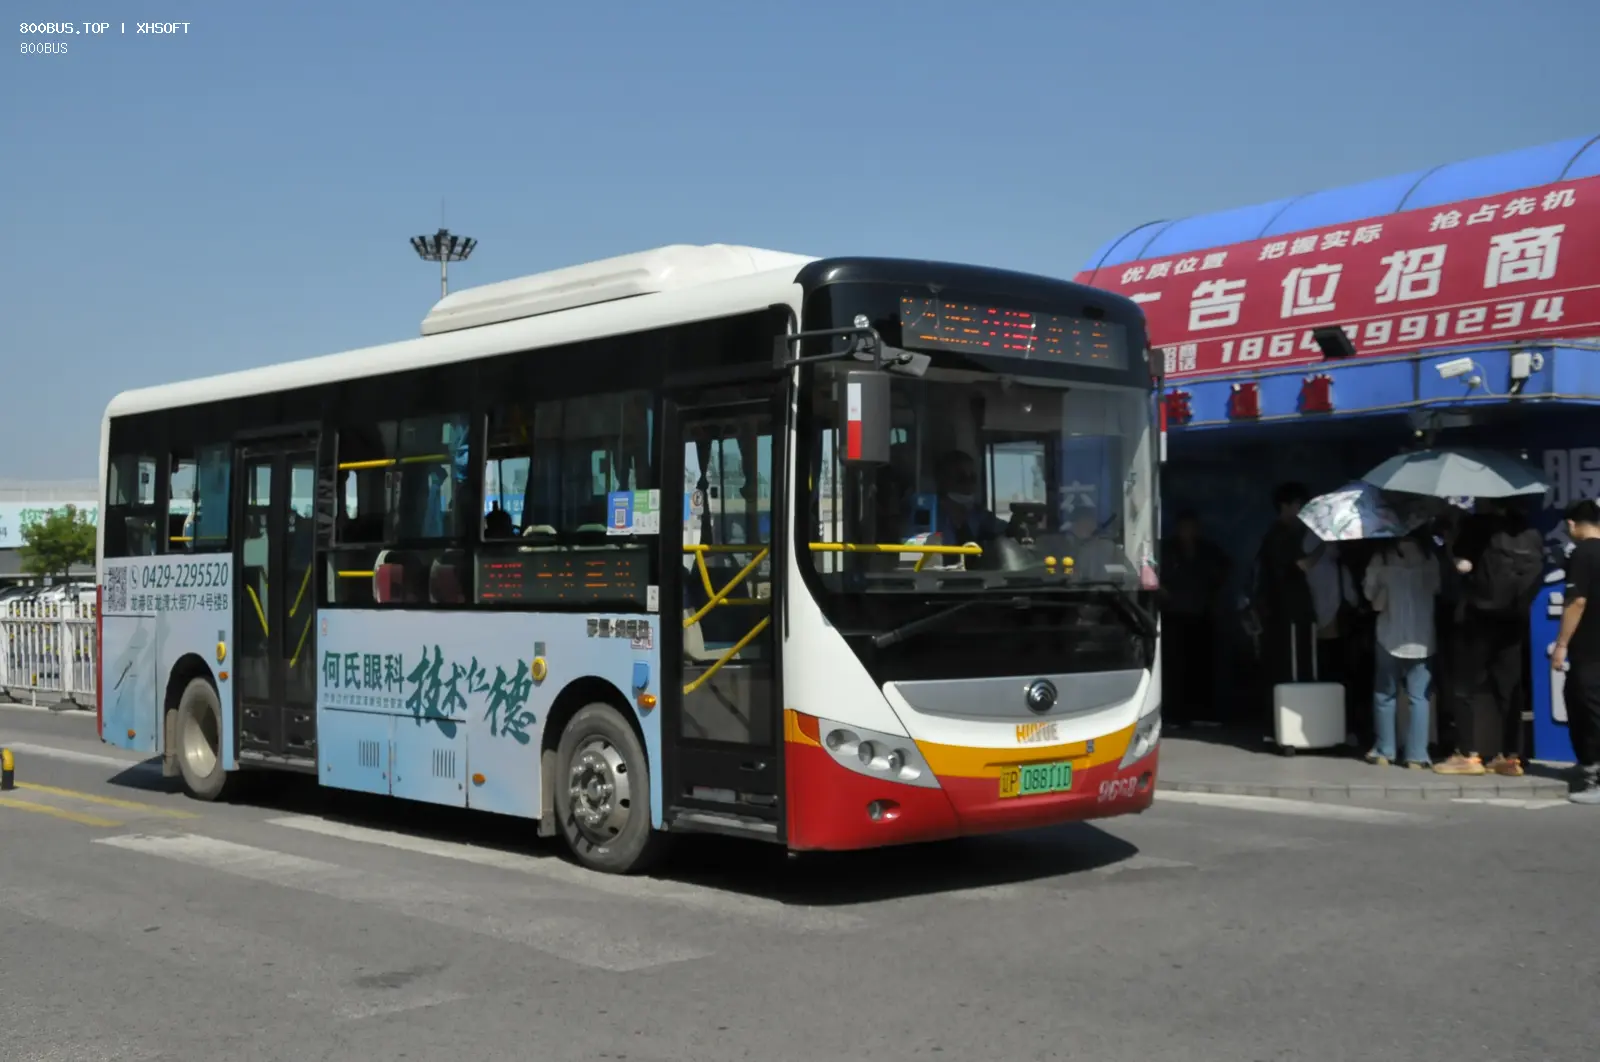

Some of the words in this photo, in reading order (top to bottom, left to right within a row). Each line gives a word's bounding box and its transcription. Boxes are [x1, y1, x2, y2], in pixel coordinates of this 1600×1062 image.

[1120, 252, 1228, 285] 优质位置
[1258, 223, 1384, 262] 把握实际
[1429, 188, 1577, 233] 抢占先机
[142, 562, 229, 589] 0429-2295520
[322, 650, 405, 694] 何氏眼科
[405, 644, 537, 745] 技术仁德
